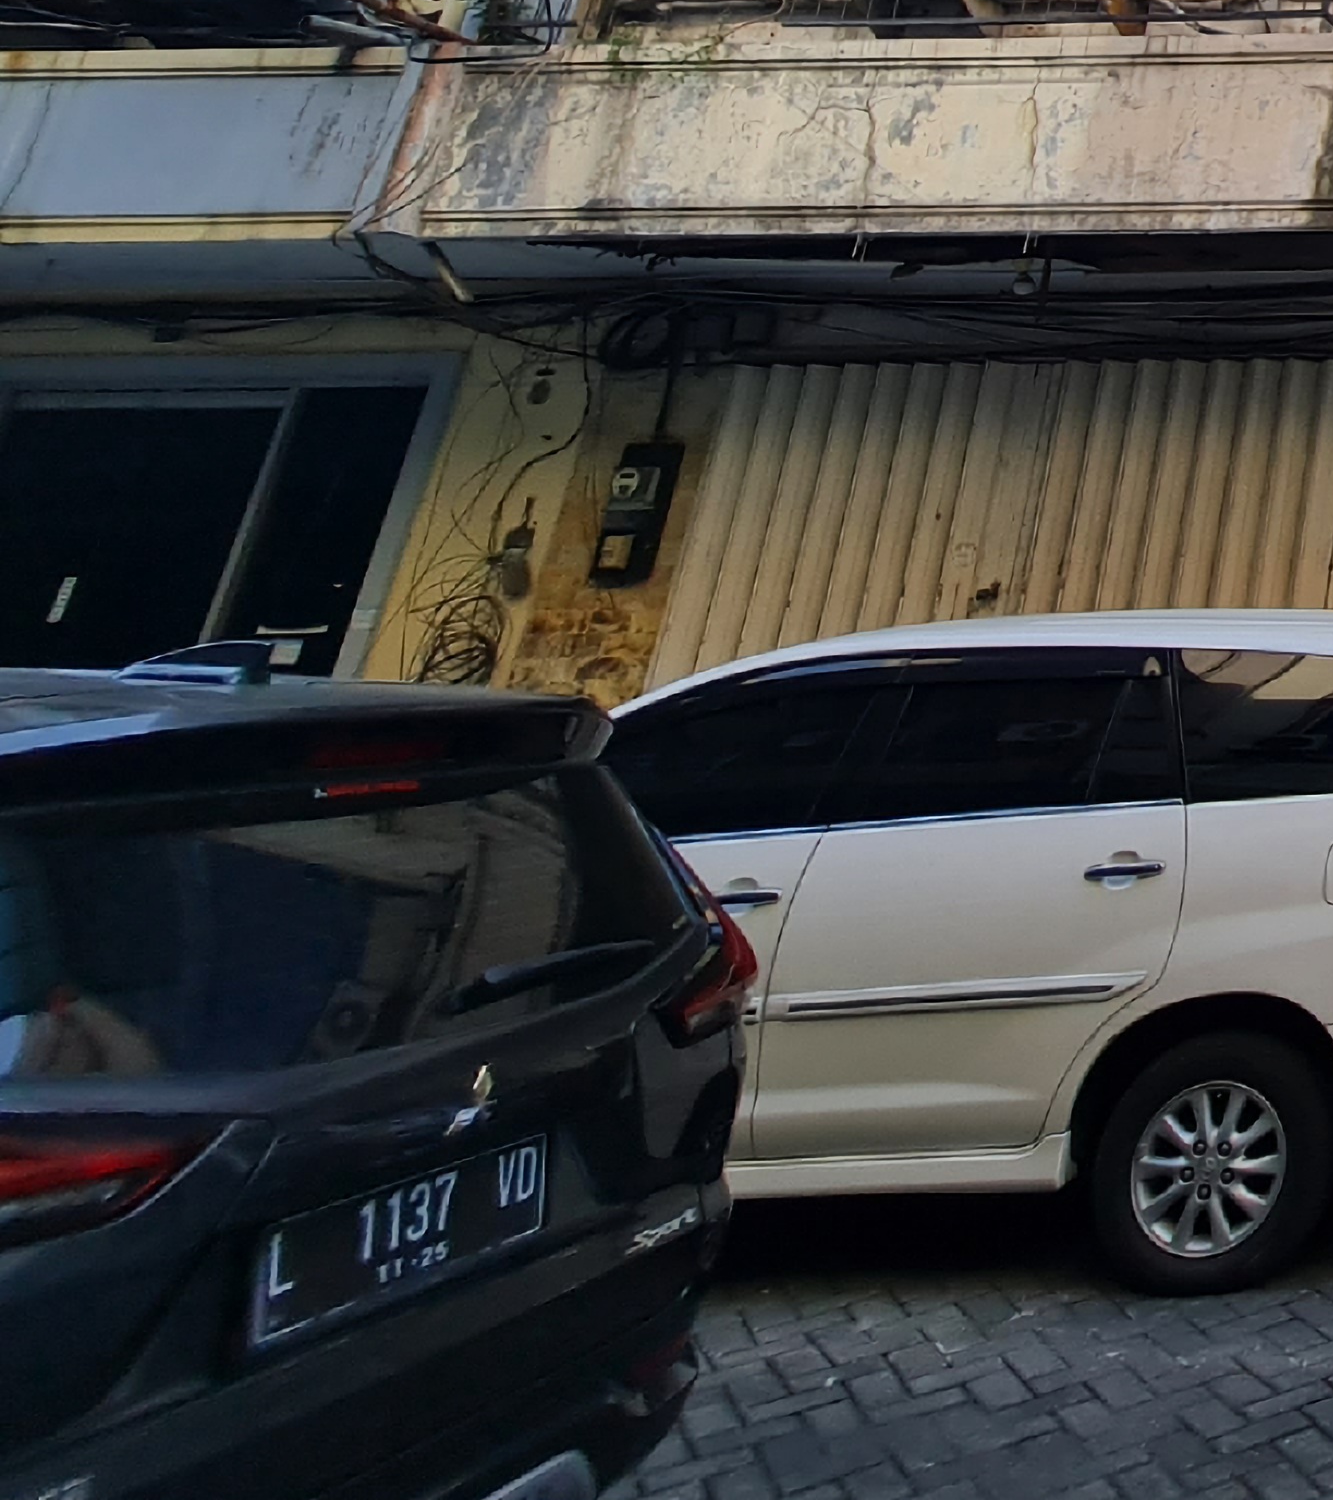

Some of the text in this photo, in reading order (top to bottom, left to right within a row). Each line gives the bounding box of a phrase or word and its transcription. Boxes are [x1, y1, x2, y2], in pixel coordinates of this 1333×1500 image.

[268, 1146, 538, 1297] L 1137 VD
[624, 1206, 698, 1256] Sport
